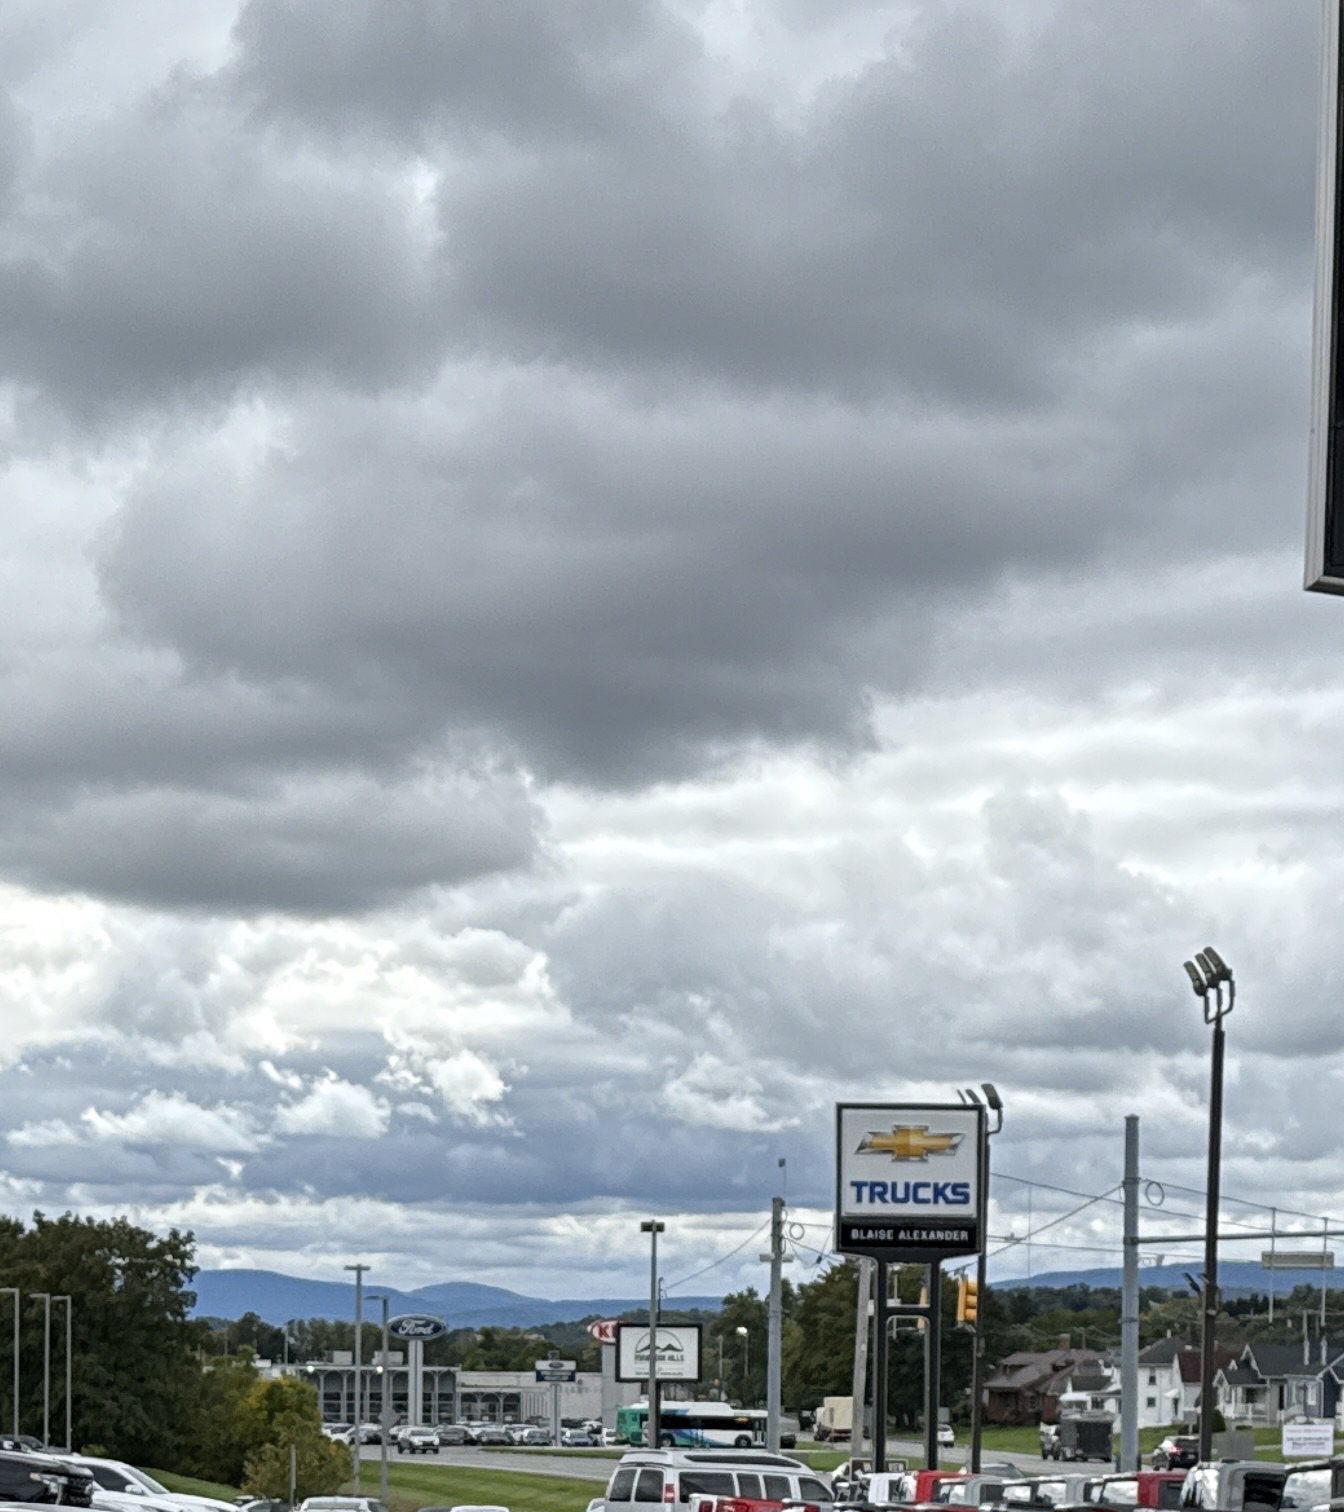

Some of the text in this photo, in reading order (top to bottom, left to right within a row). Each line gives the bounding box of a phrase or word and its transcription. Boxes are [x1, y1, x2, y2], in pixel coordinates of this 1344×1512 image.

[850, 1180, 971, 1205] TRUCKS
[851, 1228, 969, 1242] BLAISE ALEXANDER
[398, 1319, 435, 1335] Ford
